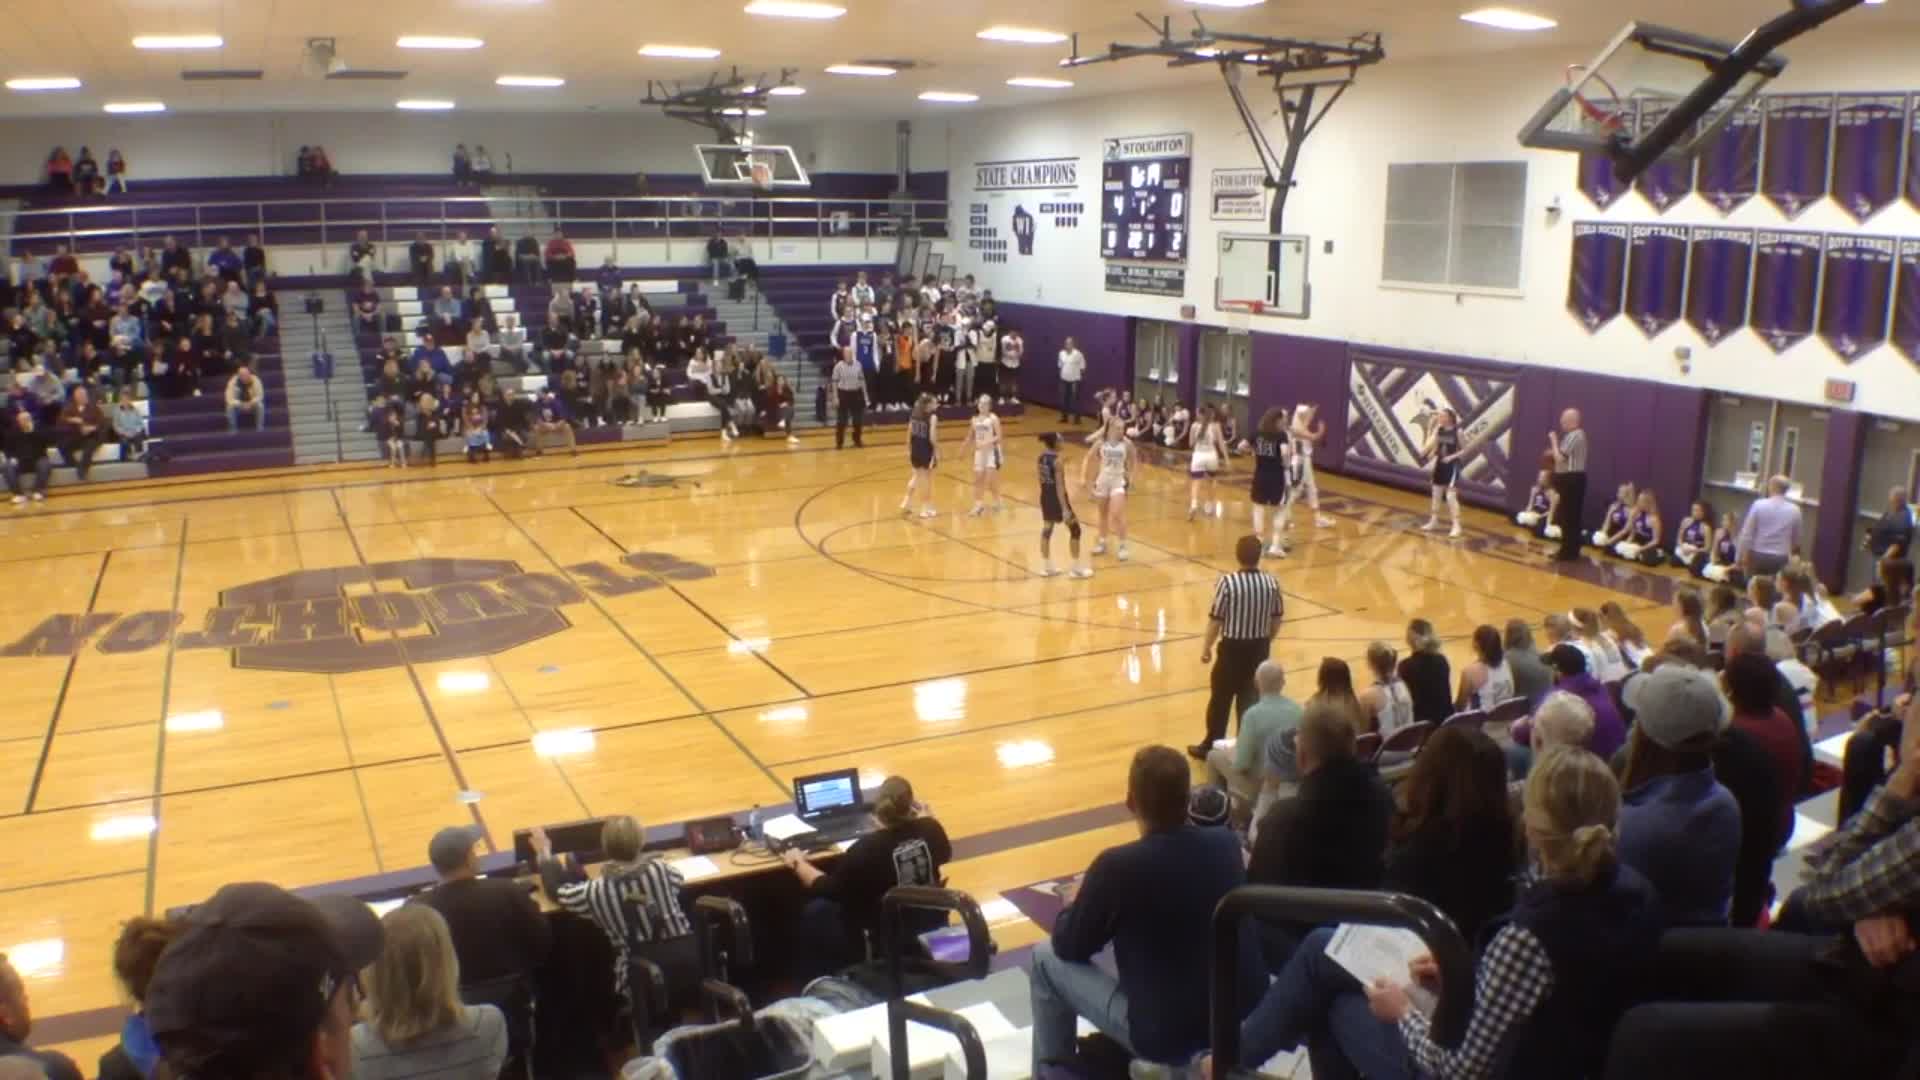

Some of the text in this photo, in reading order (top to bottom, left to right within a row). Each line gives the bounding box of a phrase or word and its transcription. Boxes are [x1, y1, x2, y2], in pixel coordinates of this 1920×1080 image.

[1123, 139, 1184, 154] STOUGHTON
[975, 163, 1077, 186] STATE CHAMPIONS
[1170, 193, 1183, 217] 0
[1632, 225, 1686, 241] SOFTBALL
[0, 551, 718, 659] STOUGHTON
